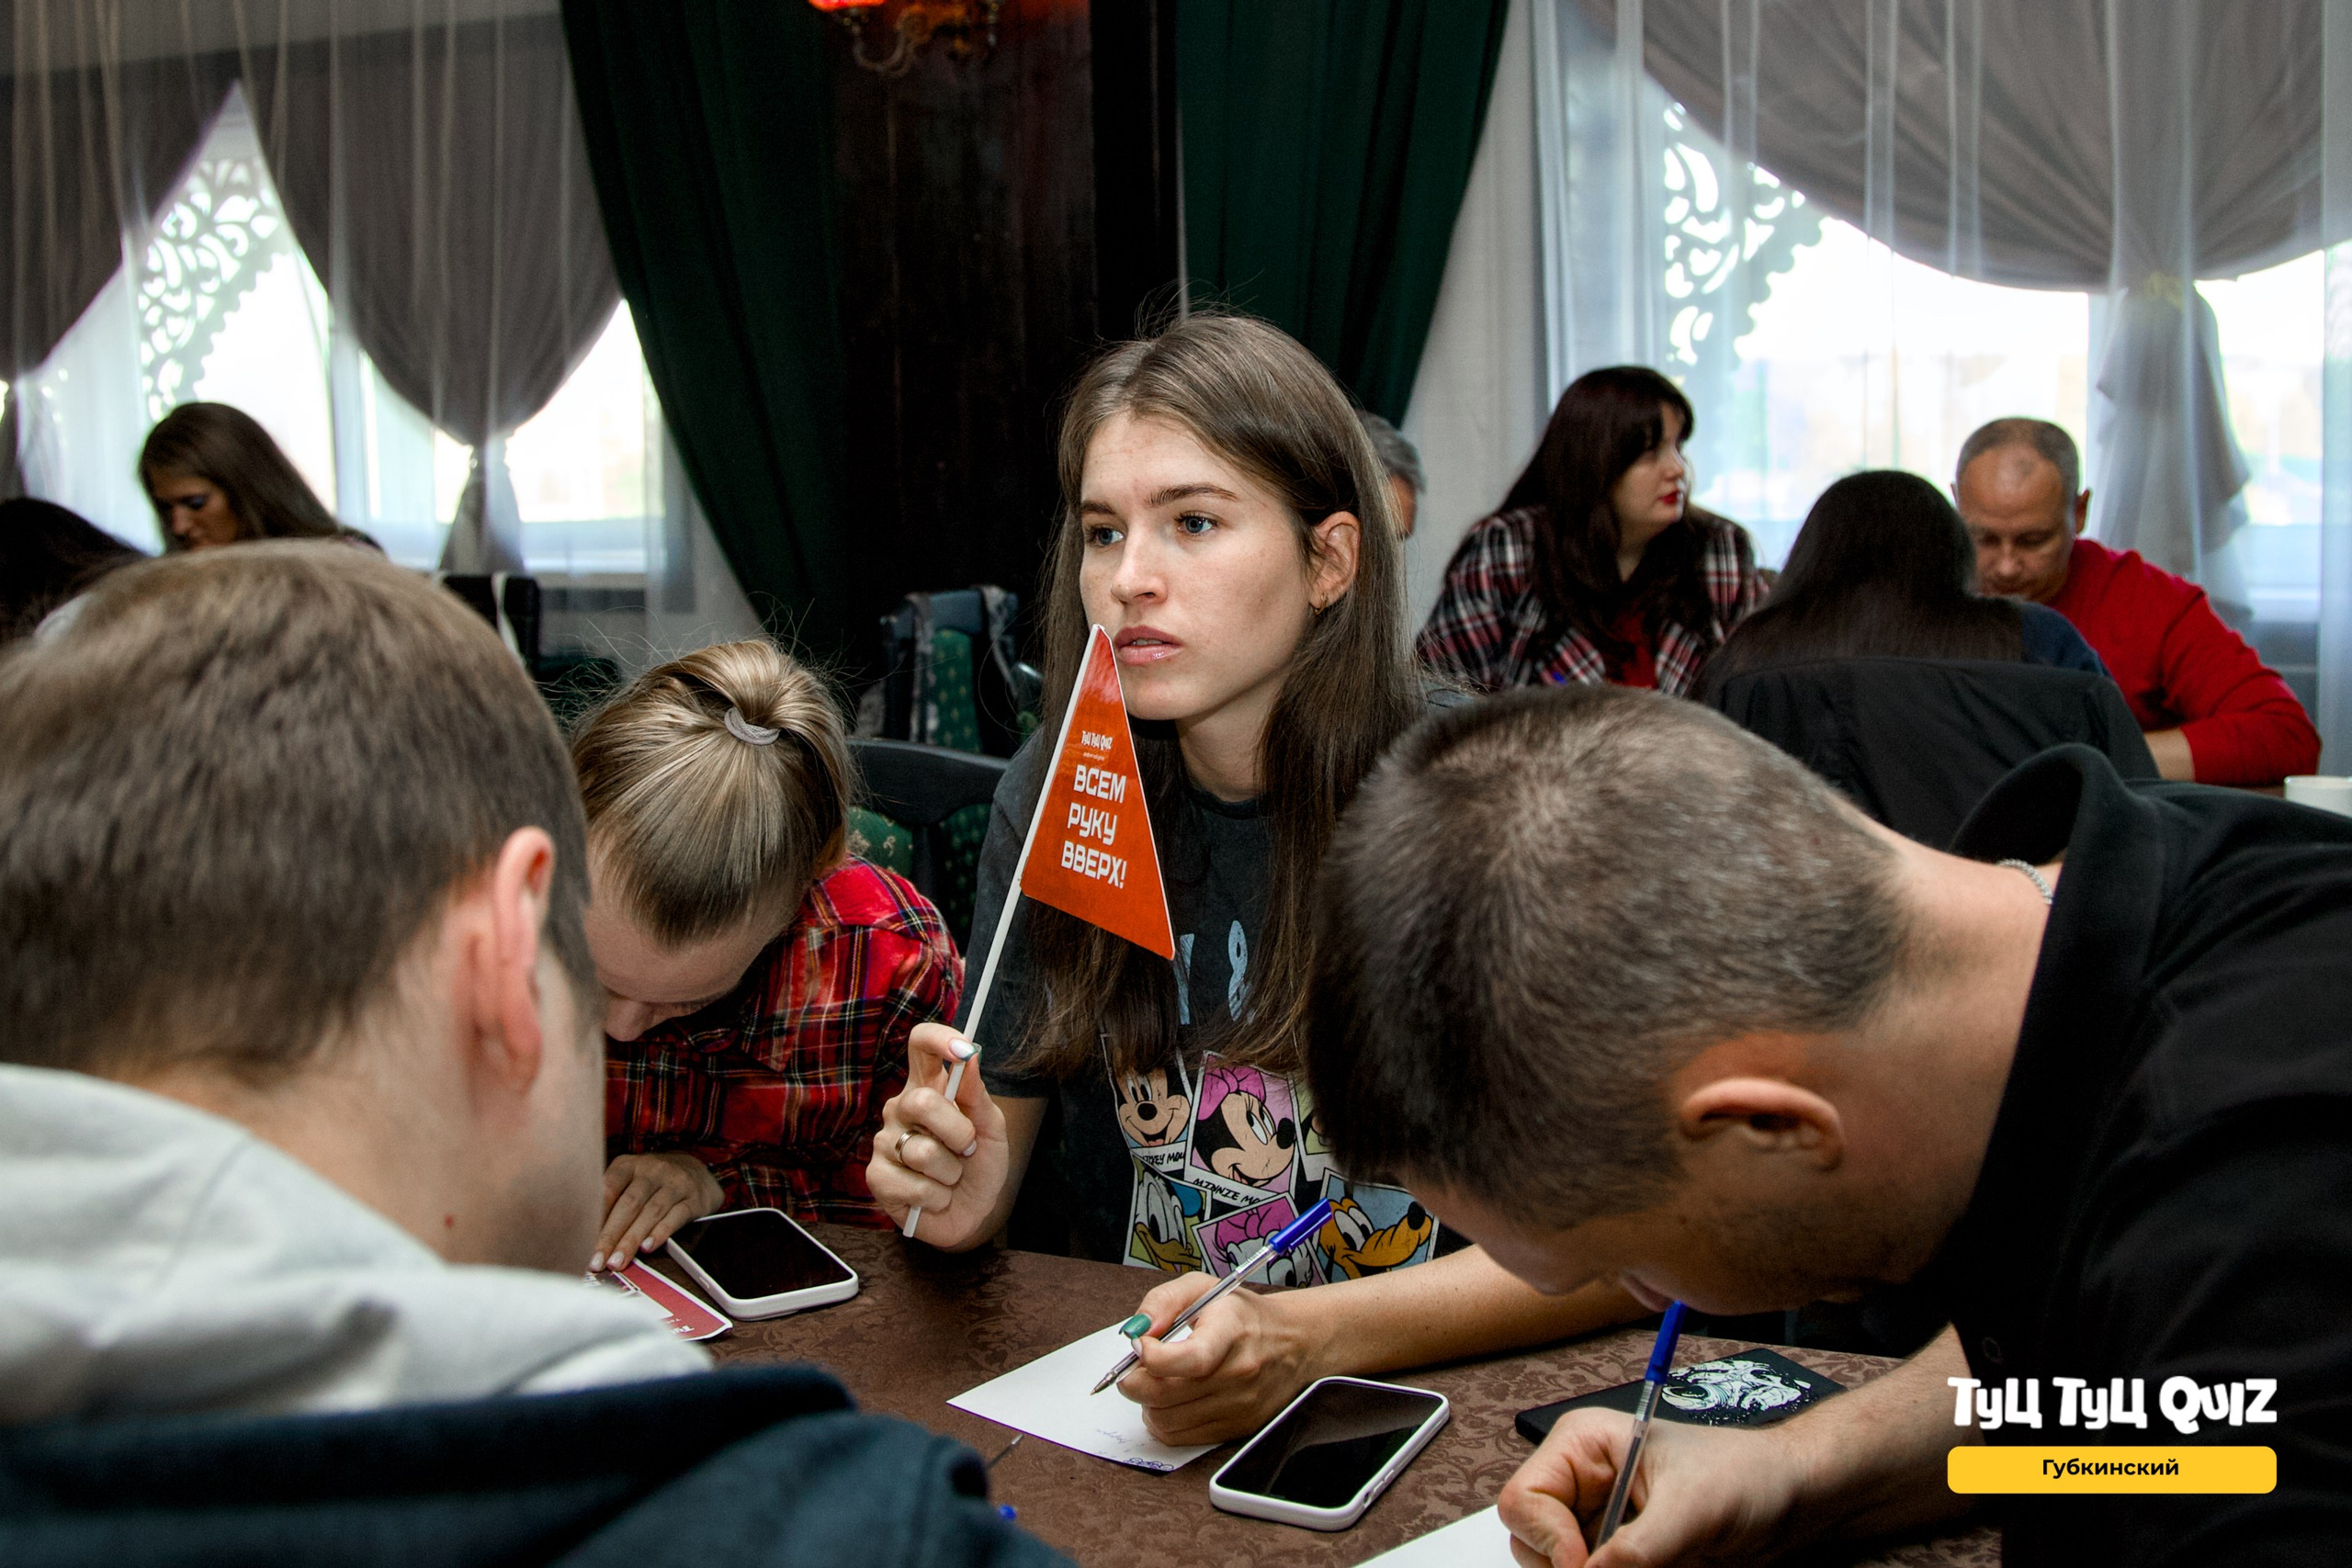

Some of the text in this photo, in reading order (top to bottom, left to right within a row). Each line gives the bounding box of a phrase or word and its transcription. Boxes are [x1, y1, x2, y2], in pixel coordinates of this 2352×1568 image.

[1073, 764, 1126, 804] ВСЕМ
[1067, 802, 1117, 846] РУКУ
[1060, 840, 1127, 889] ВВЕРХ!
[1193, 1178, 1240, 1201] MINNIE
